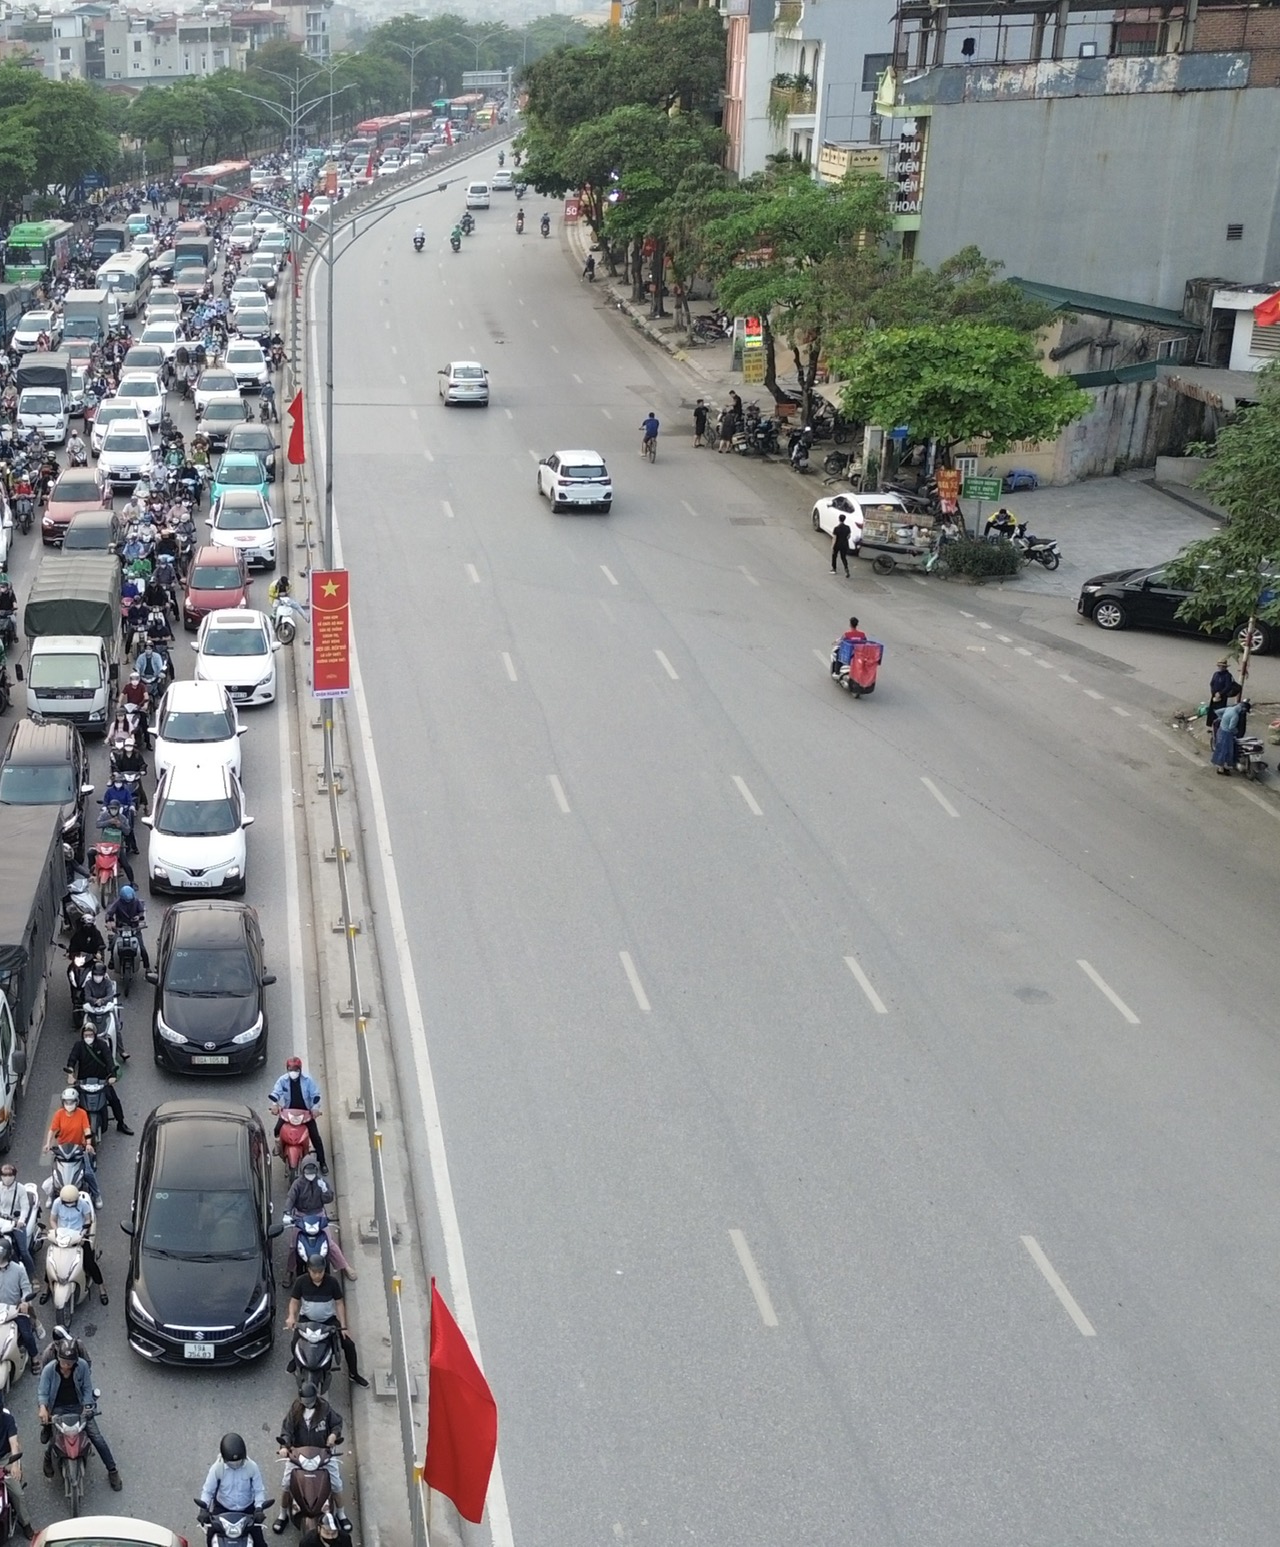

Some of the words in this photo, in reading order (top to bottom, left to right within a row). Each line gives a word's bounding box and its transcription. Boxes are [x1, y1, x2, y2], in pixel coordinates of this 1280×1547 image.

[898, 142, 920, 155] PHỤ
[894, 159, 919, 175] KIỆN
[566, 207, 577, 216] 50
